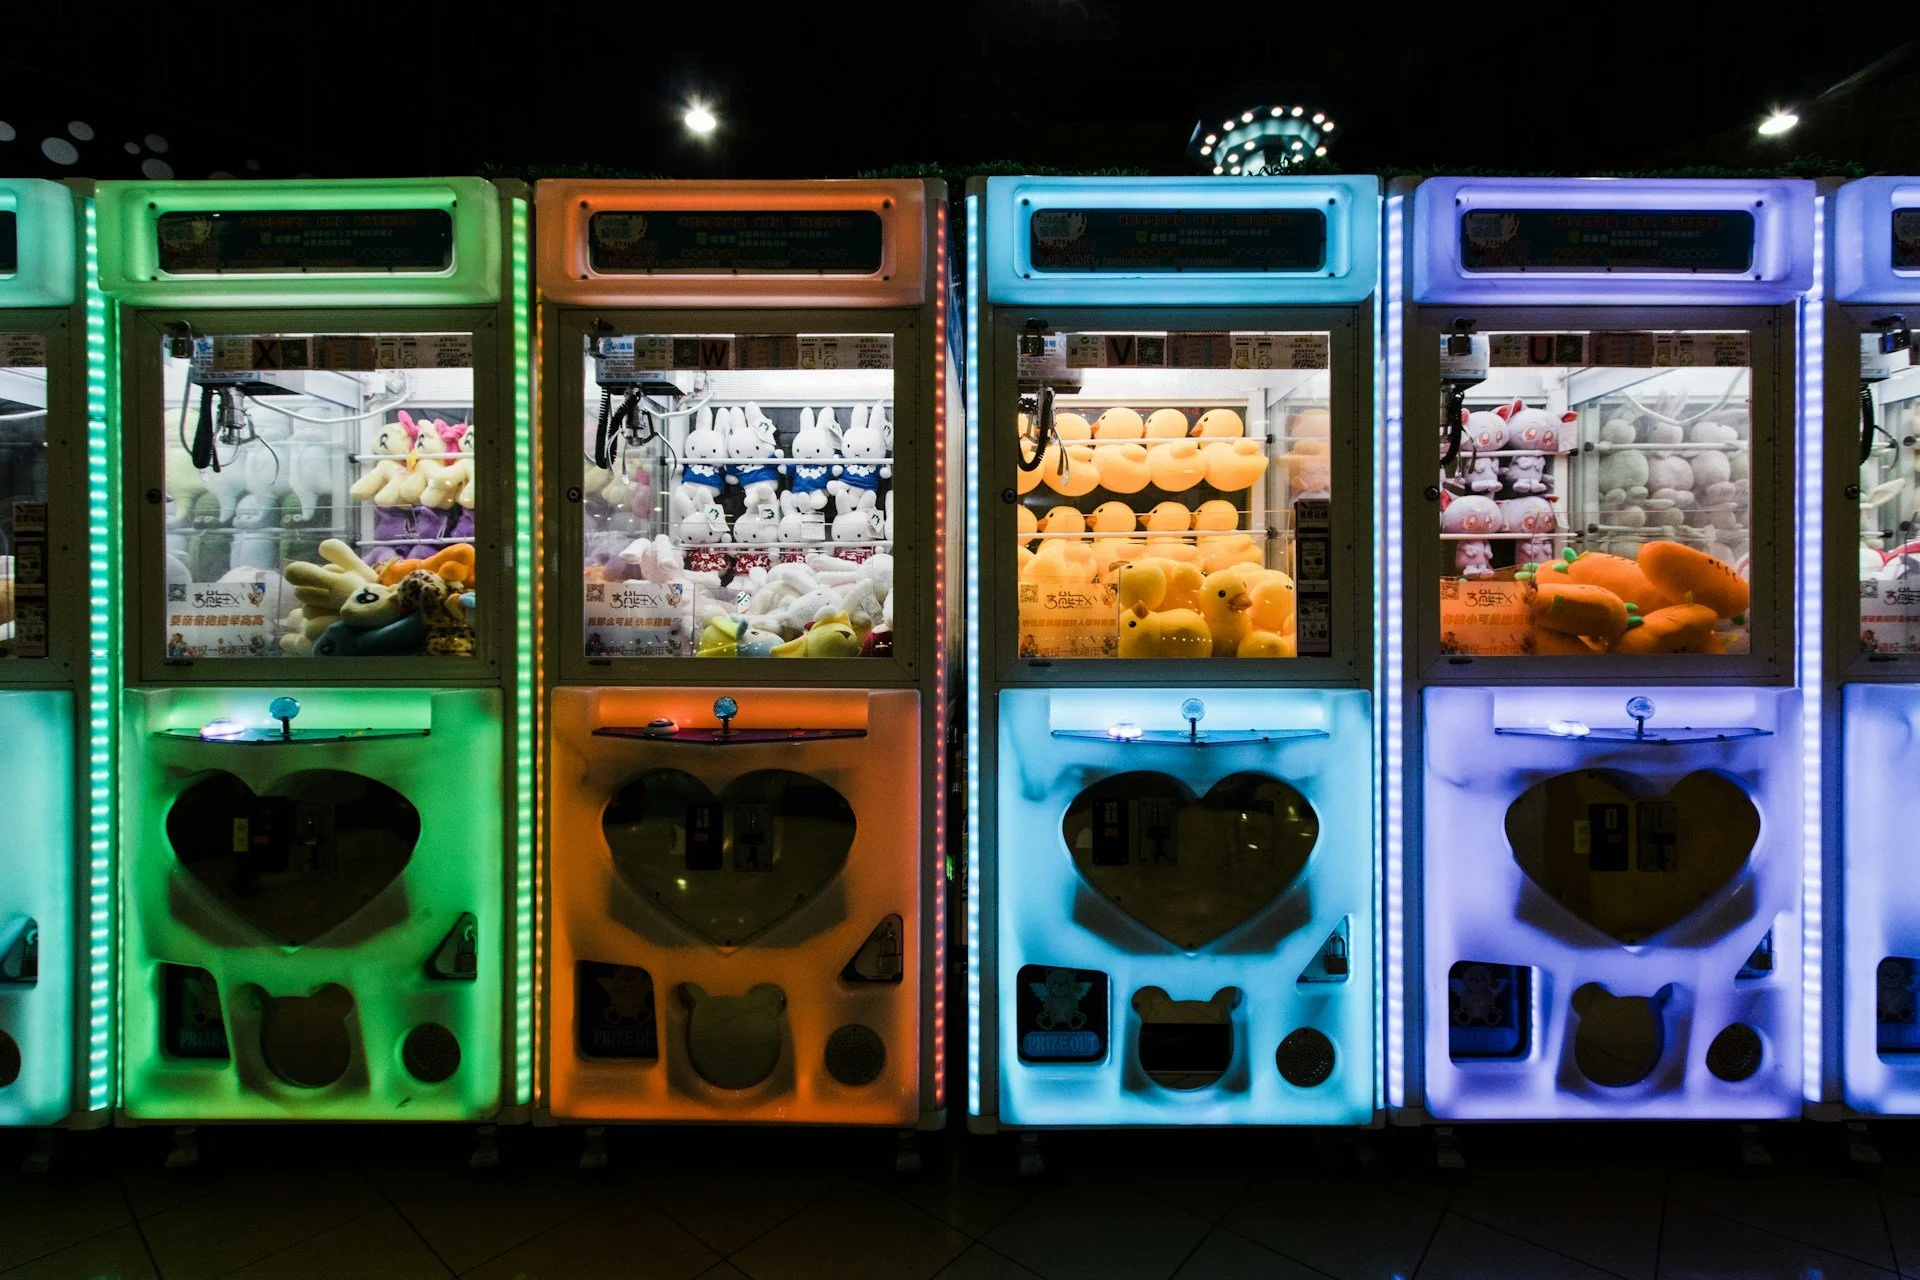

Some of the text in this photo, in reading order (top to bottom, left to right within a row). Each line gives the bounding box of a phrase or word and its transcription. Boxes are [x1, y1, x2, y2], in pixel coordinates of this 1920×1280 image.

[255, 340, 277, 367] X
[701, 342, 726, 367] W
[1110, 337, 1134, 365] V
[1530, 336, 1553, 365] U
[170, 614, 265, 627] 要亲亲抱抱举高高
[179, 1031, 220, 1048] PRIZE
[594, 1030, 633, 1046] PRIZE
[1028, 1035, 1096, 1052] PRIZE OUT
